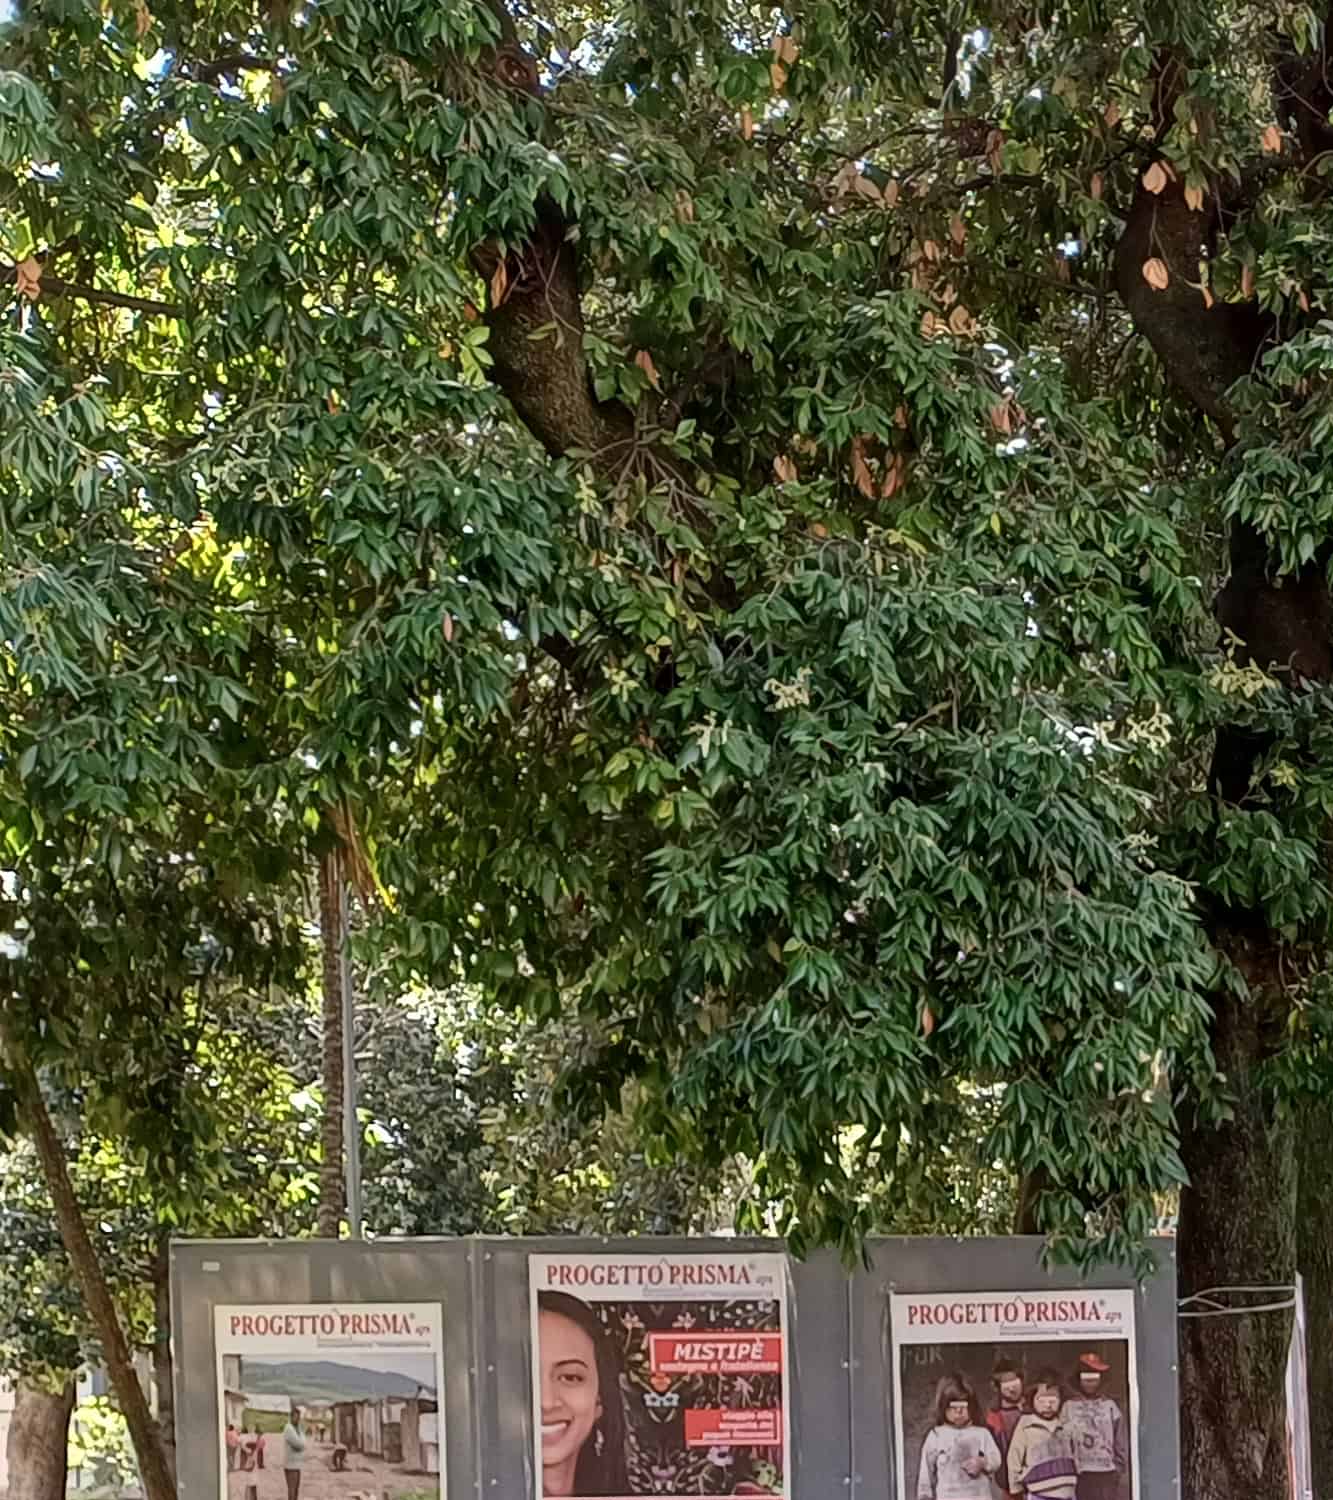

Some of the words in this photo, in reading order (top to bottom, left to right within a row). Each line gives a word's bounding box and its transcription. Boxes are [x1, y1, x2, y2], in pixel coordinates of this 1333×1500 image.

[547, 1264, 664, 1286] PROGETTO
[230, 1313, 335, 1336] PROGETTO
[908, 1302, 1019, 1325] PROGETTO
